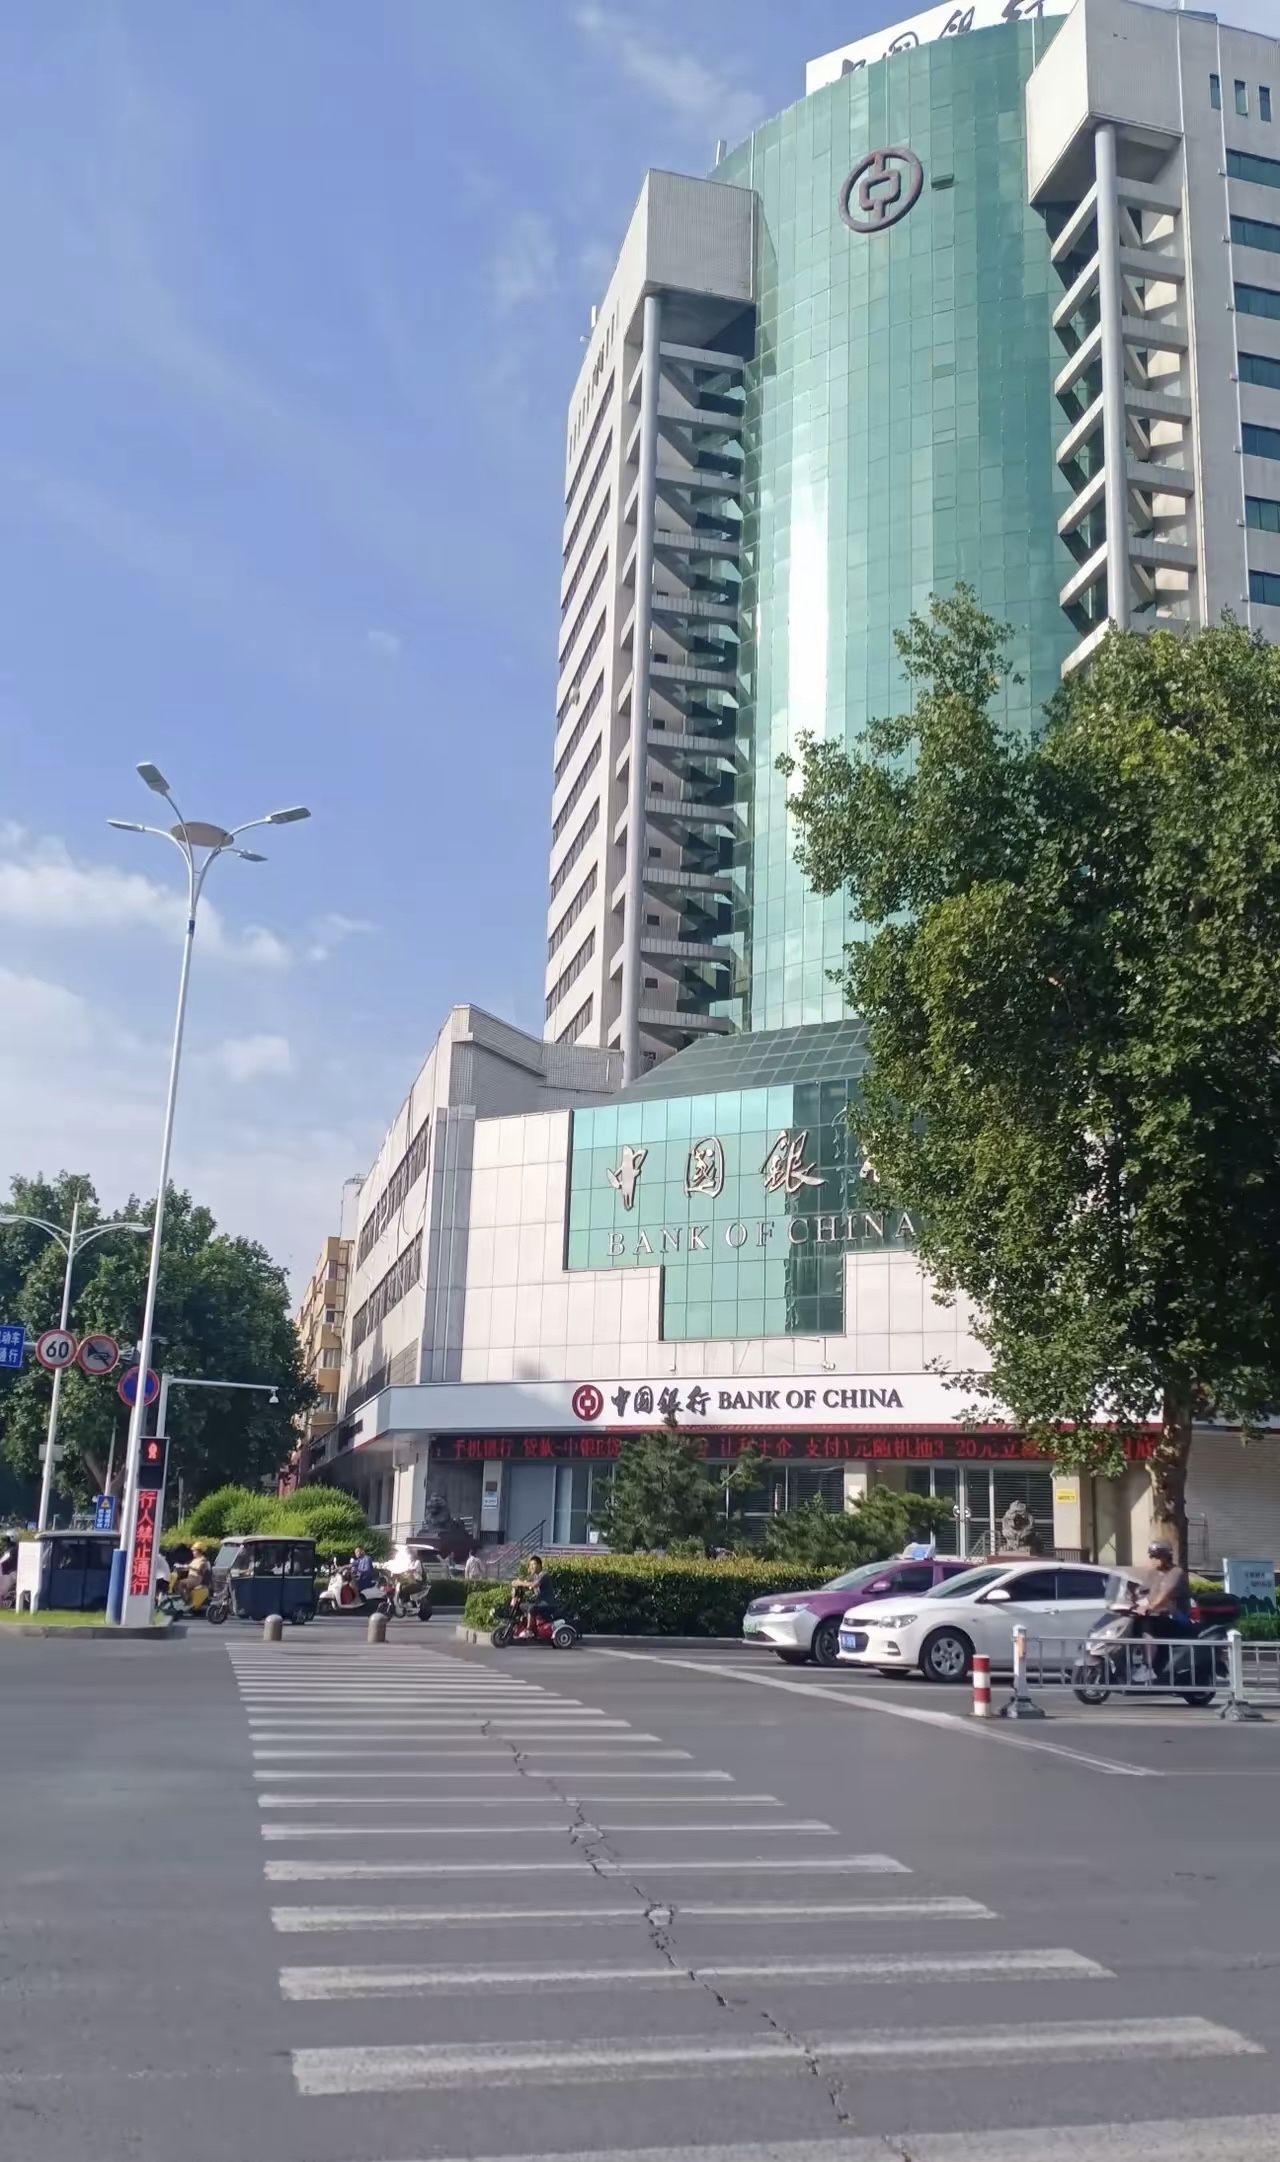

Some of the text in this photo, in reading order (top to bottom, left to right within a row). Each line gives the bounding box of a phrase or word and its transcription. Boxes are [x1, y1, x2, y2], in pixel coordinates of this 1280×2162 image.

[606, 1129, 881, 1211] 中国银
[606, 1211, 917, 1257] BANK OF CHINA
[0, 1331, 21, 1346] 动车
[46, 1340, 70, 1358] 60
[611, 1385, 712, 1418] 中国银行
[718, 1388, 904, 1410] BANK OF CHINA
[131, 1491, 158, 1595] 行人禁止通行
